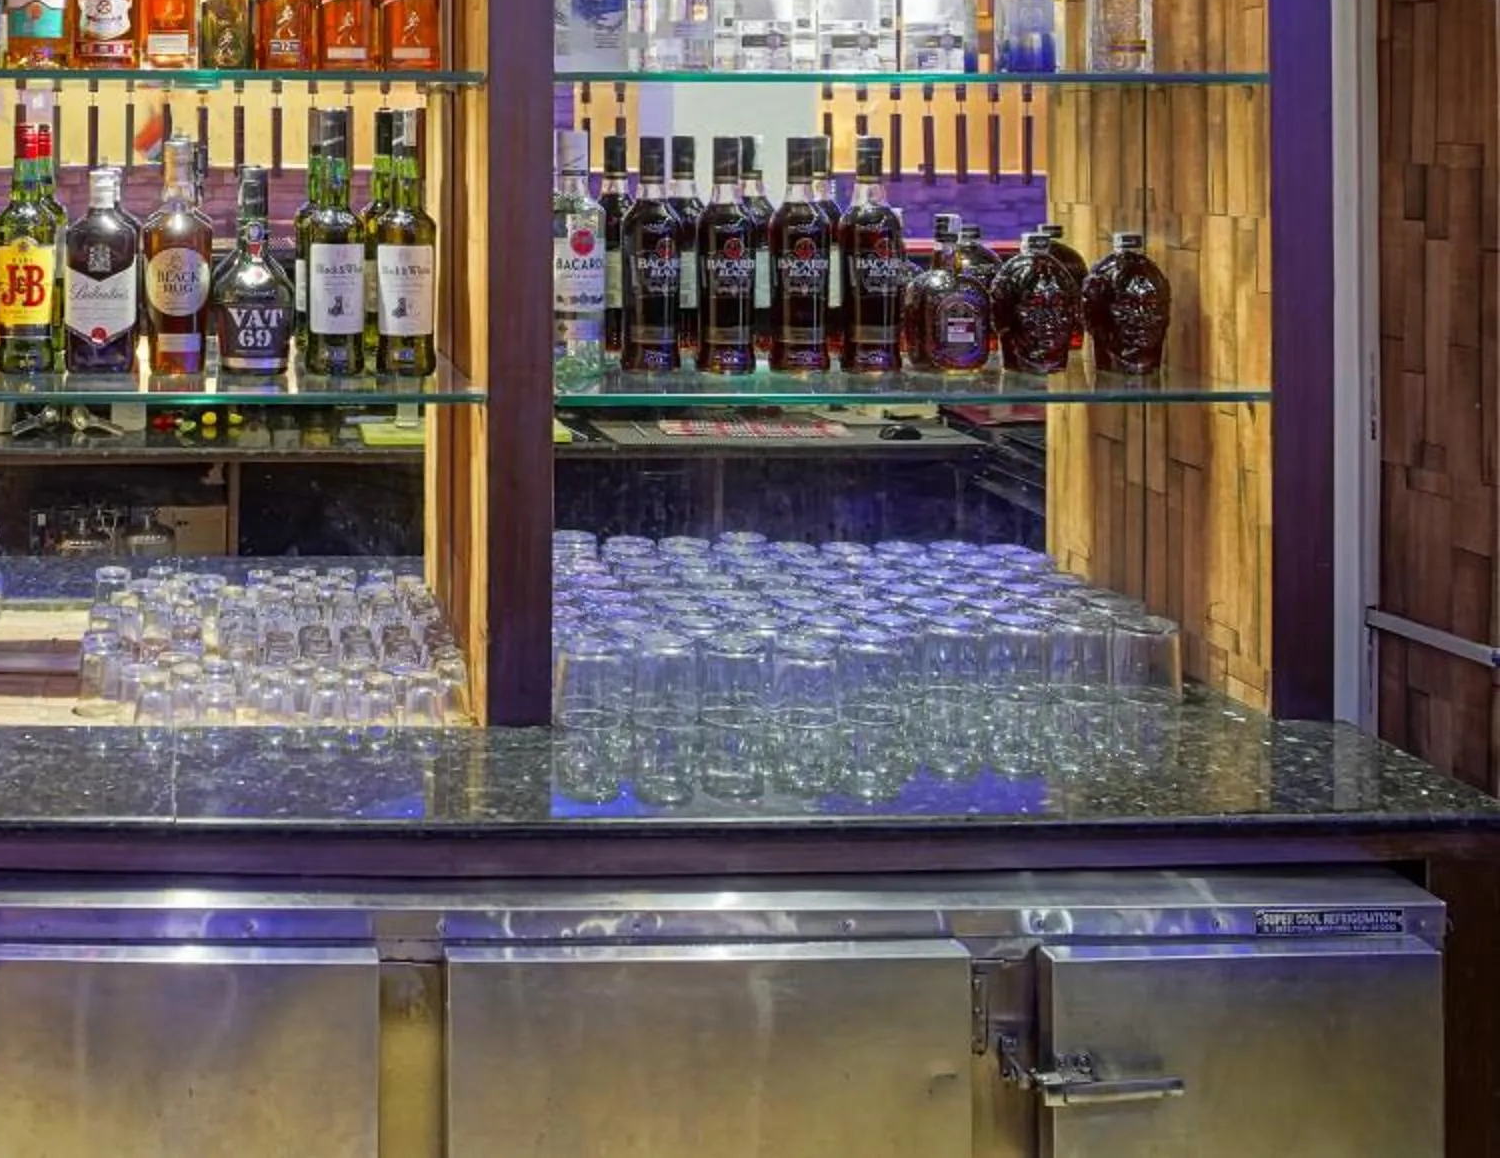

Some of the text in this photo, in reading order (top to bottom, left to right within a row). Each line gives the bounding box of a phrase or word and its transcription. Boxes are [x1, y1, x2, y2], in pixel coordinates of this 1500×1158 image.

[1, 264, 46, 307] J&B
[227, 307, 284, 329] VAT
[238, 329, 272, 347] 69
[1263, 912, 1294, 925] SUPER
[1295, 913, 1322, 925] COOL
